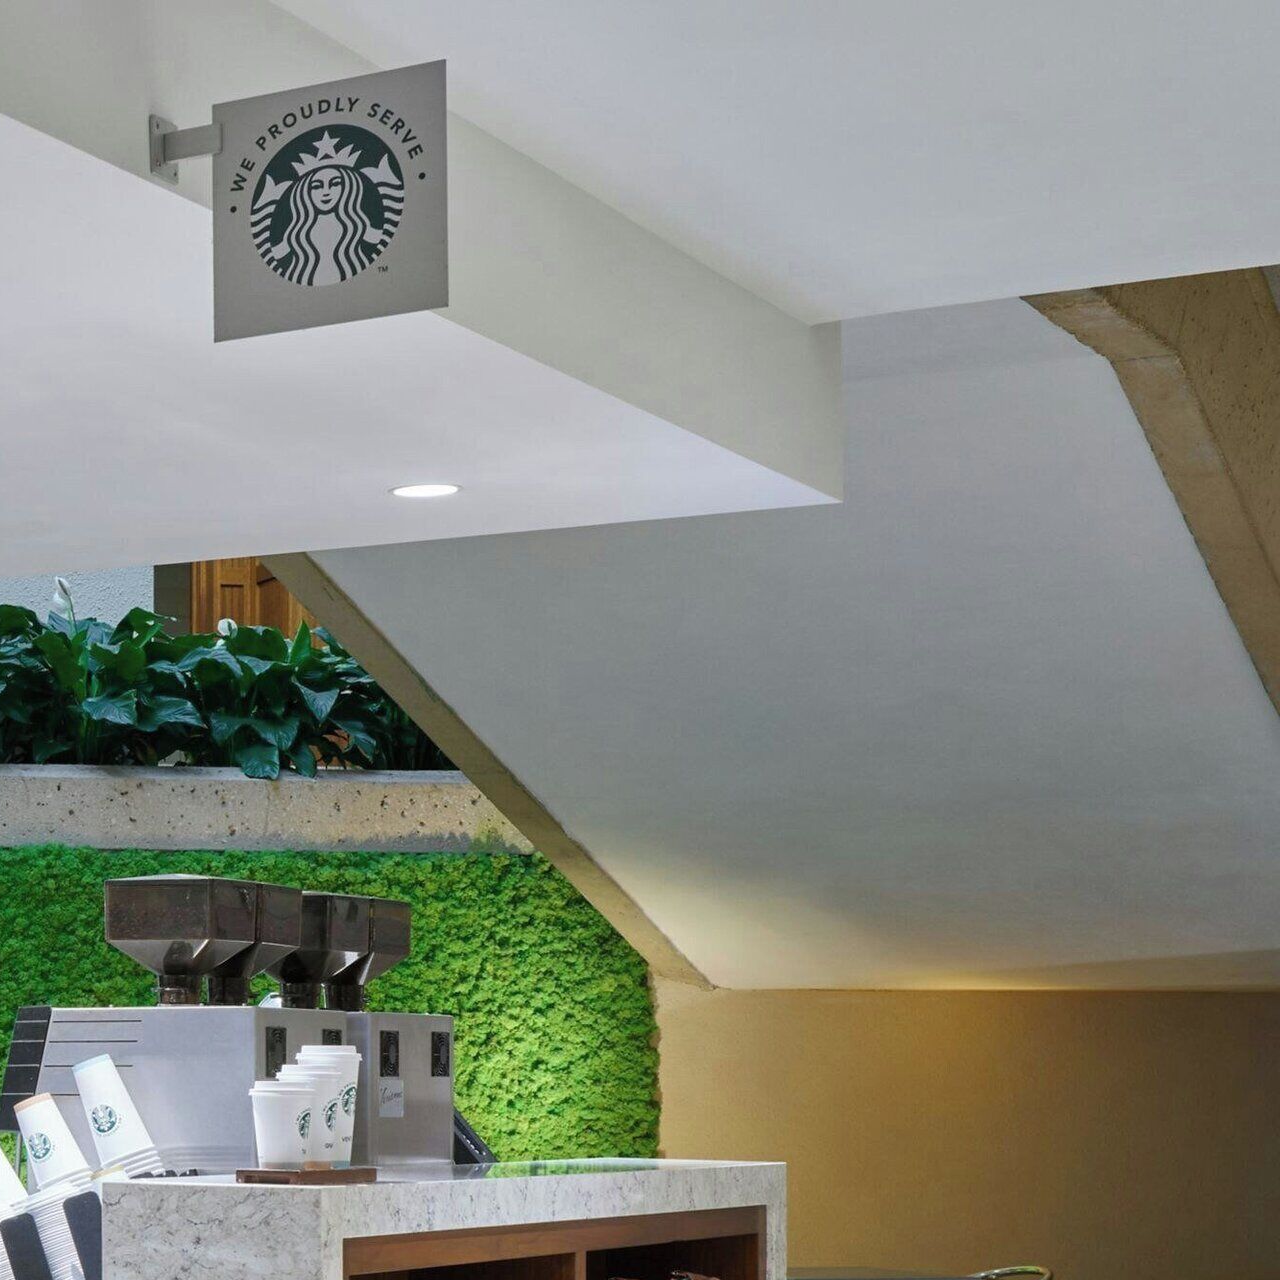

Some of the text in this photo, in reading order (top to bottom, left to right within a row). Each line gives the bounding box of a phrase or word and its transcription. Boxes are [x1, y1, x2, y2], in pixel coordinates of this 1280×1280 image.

[230, 97, 423, 192] WE PROUDLY SERVE
